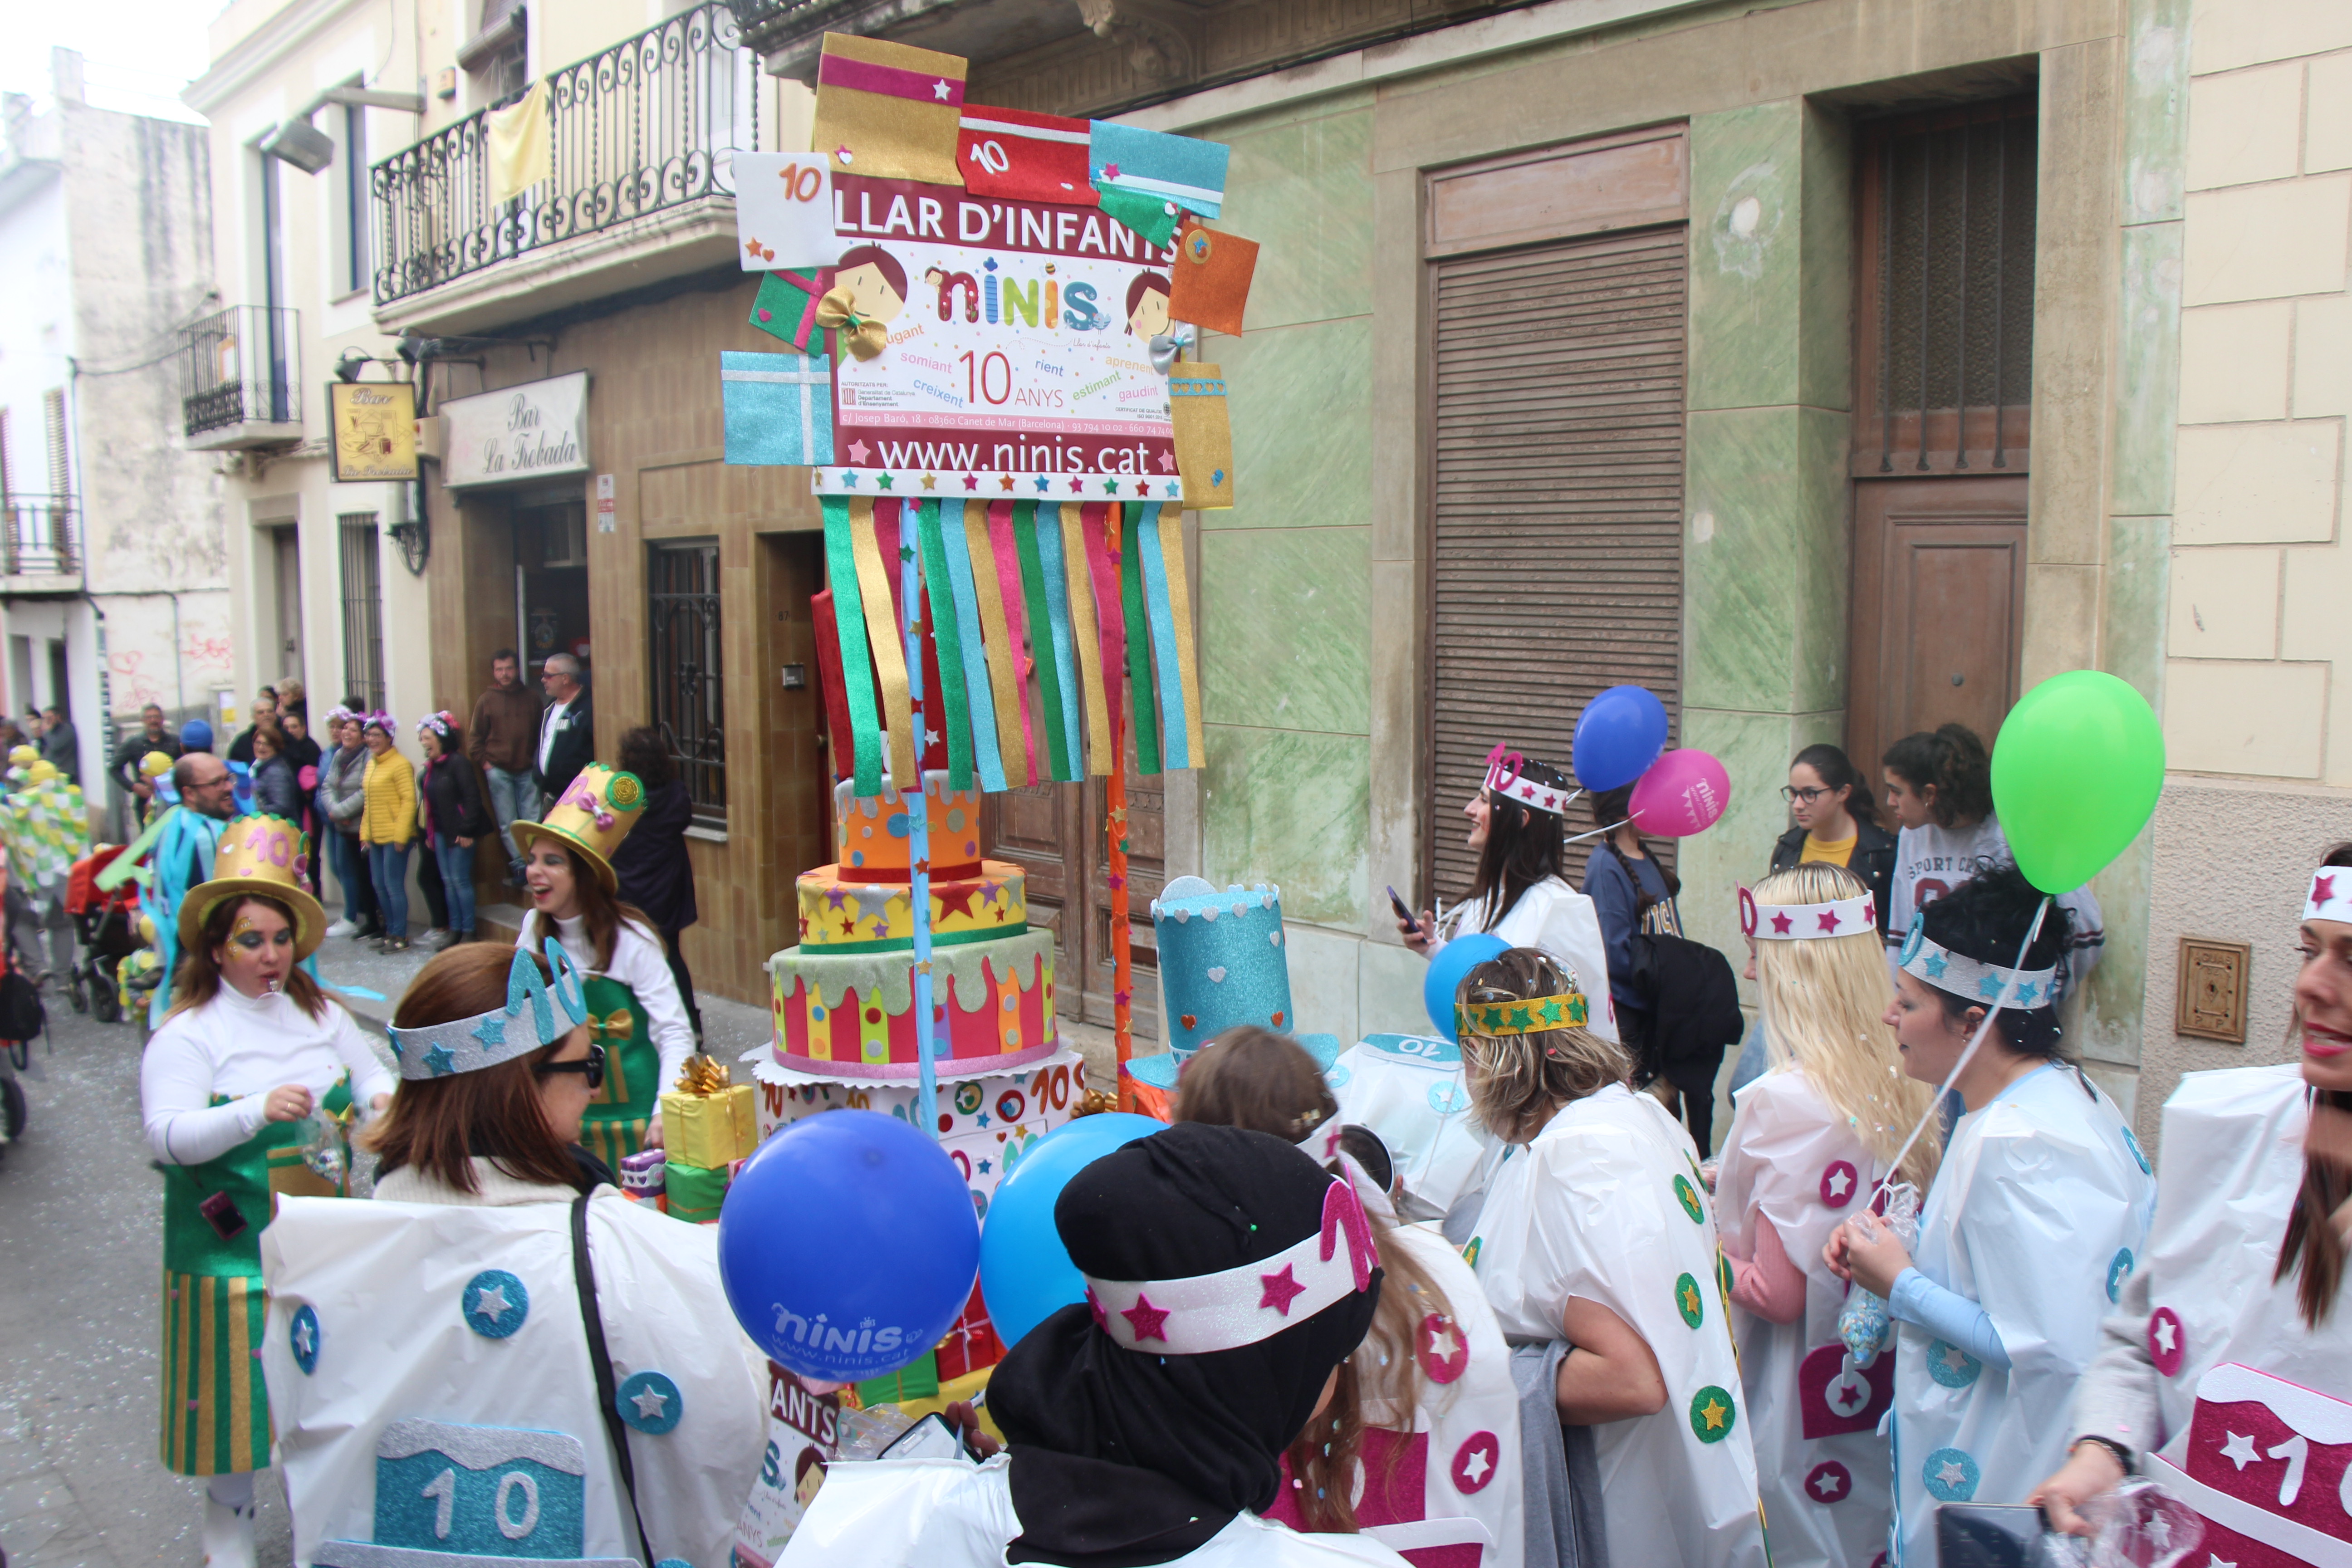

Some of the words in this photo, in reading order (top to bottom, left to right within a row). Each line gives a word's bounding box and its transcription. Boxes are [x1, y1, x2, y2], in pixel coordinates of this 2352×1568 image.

[970, 140, 1009, 175] 10
[779, 162, 822, 202] 10
[834, 189, 945, 238] LLAR
[885, 323, 925, 345] ugant
[900, 353, 952, 374] somiant
[958, 350, 1011, 405] 10
[1014, 387, 1063, 407] ANYS
[1035, 359, 1064, 377] rient
[1105, 356, 1154, 375] aprenent
[350, 387, 394, 404] Bar
[913, 379, 964, 408] creixent
[1073, 370, 1122, 400] estimant
[1118, 385, 1158, 402] gaudint
[507, 392, 541, 431] Bar
[843, 413, 852, 424] c/
[855, 413, 880, 425] Josep
[884, 413, 908, 424] Baró,
[912, 414, 921, 423] 18
[929, 416, 955, 426] 08360
[958, 416, 982, 426] Canet
[985, 417, 995, 426] de
[998, 418, 1015, 427] Mar
[1019, 418, 1064, 431] (Barcelona)
[1072, 423, 1081, 432] 93
[1084, 423, 1099, 432] 794
[1129, 423, 1144, 432] 660
[1147, 426, 1156, 435] 74
[1158, 426, 1165, 435] 74
[482, 437, 504, 474] La
[877, 433, 1150, 475] www.ninis.cat
[1485, 741, 1523, 791] 10
[245, 825, 289, 867] 10
[1909, 857, 1952, 879] SPORT
[506, 936, 588, 1045] 10
[1030, 1064, 1069, 1115] 10
[421, 1468, 539, 1539] 10
